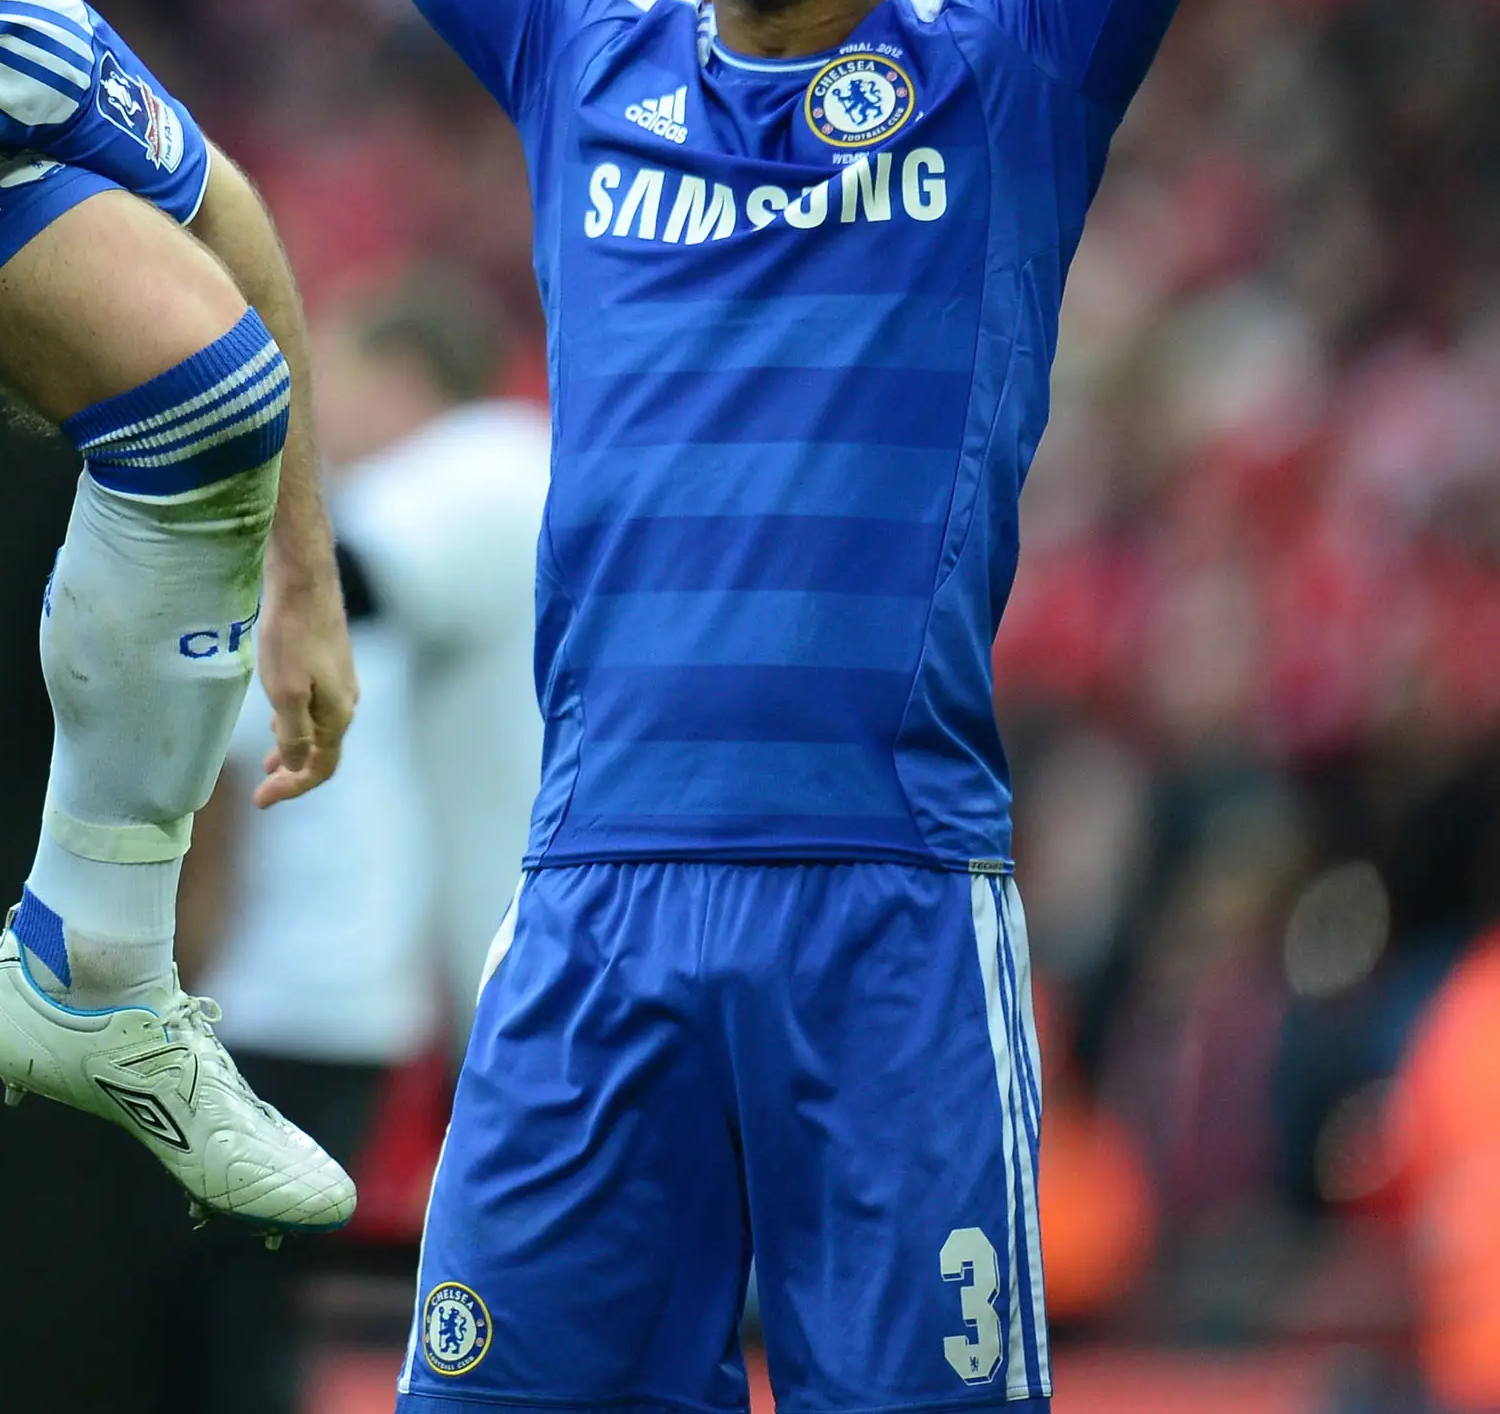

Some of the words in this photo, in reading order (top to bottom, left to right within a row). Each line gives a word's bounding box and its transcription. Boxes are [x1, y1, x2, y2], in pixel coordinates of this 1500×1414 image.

[839, 42, 874, 55] FINAL
[876, 43, 904, 59] 2012
[814, 61, 875, 97] CHELSEA
[624, 105, 688, 145] adidas
[842, 126, 887, 142] FOOTBALL
[887, 107, 905, 126] CLUB
[584, 147, 947, 245] SAMSUNG
[431, 1289, 474, 1310] CHELSEA
[939, 1227, 1003, 1386] 3
[457, 1356, 475, 1369] CLUB
